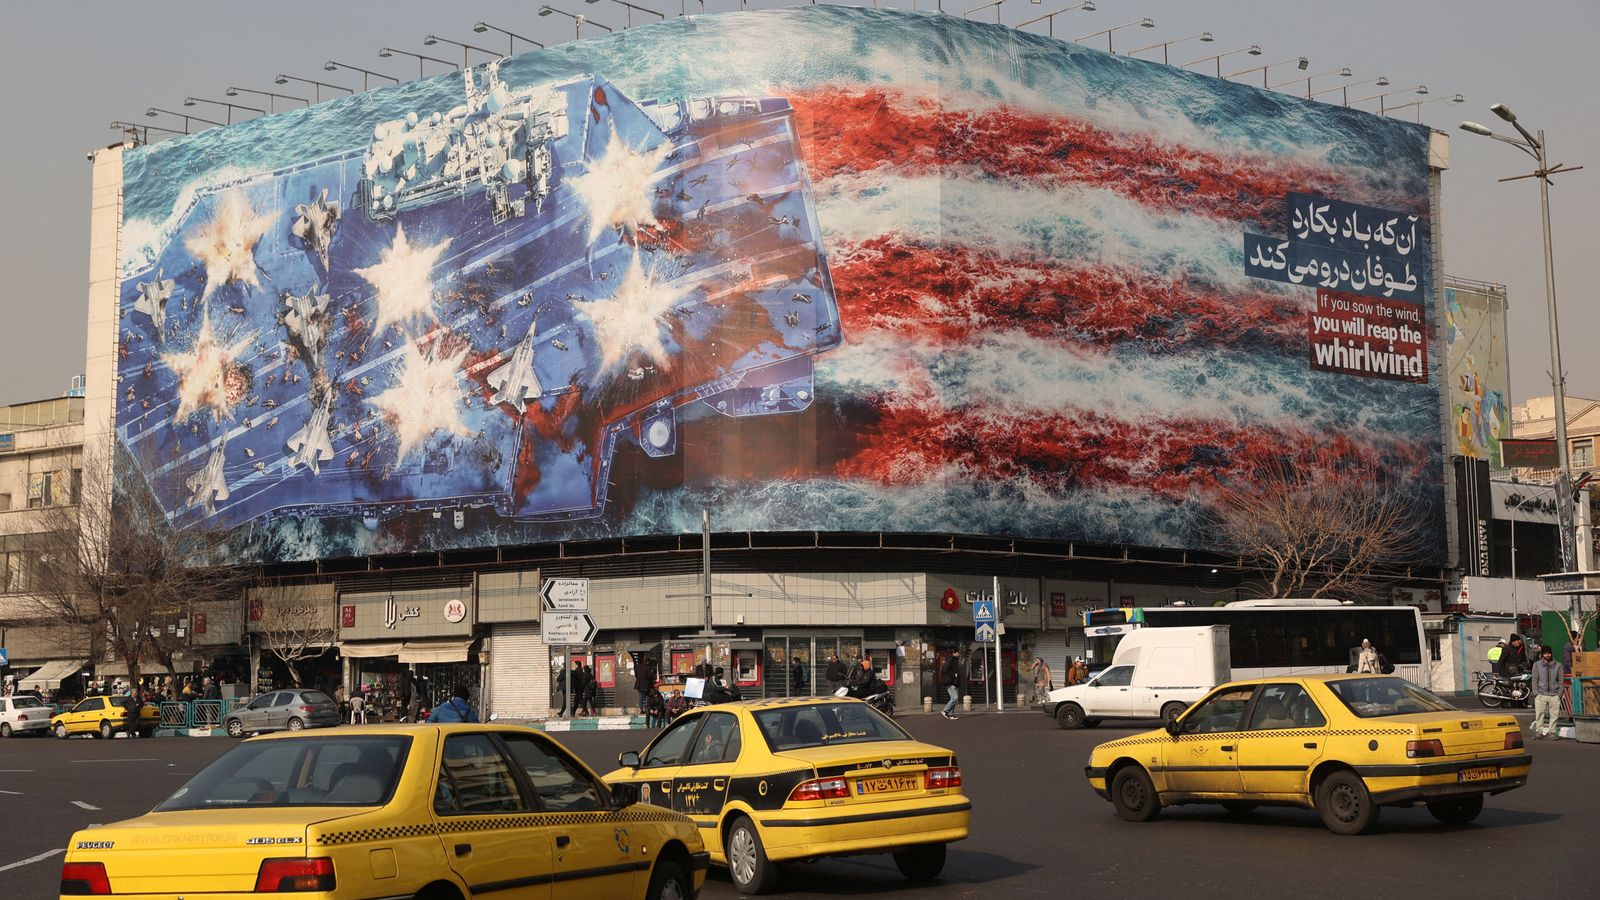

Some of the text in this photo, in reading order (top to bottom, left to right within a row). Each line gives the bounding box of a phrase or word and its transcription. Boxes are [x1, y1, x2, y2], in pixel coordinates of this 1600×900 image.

[1292, 202, 1338, 243] بکارد
[1342, 210, 1371, 250] باد
[1350, 255, 1417, 297] طوفان
[1320, 295, 1421, 324] If you sow the wind,
[1313, 316, 1422, 345] you will reap the
[1314, 338, 1423, 377] whirlwind
[1479, 520, 1490, 576] SAMSUNG
[399, 606, 420, 620] کفش
[77, 841, 114, 849] PEUGEOT
